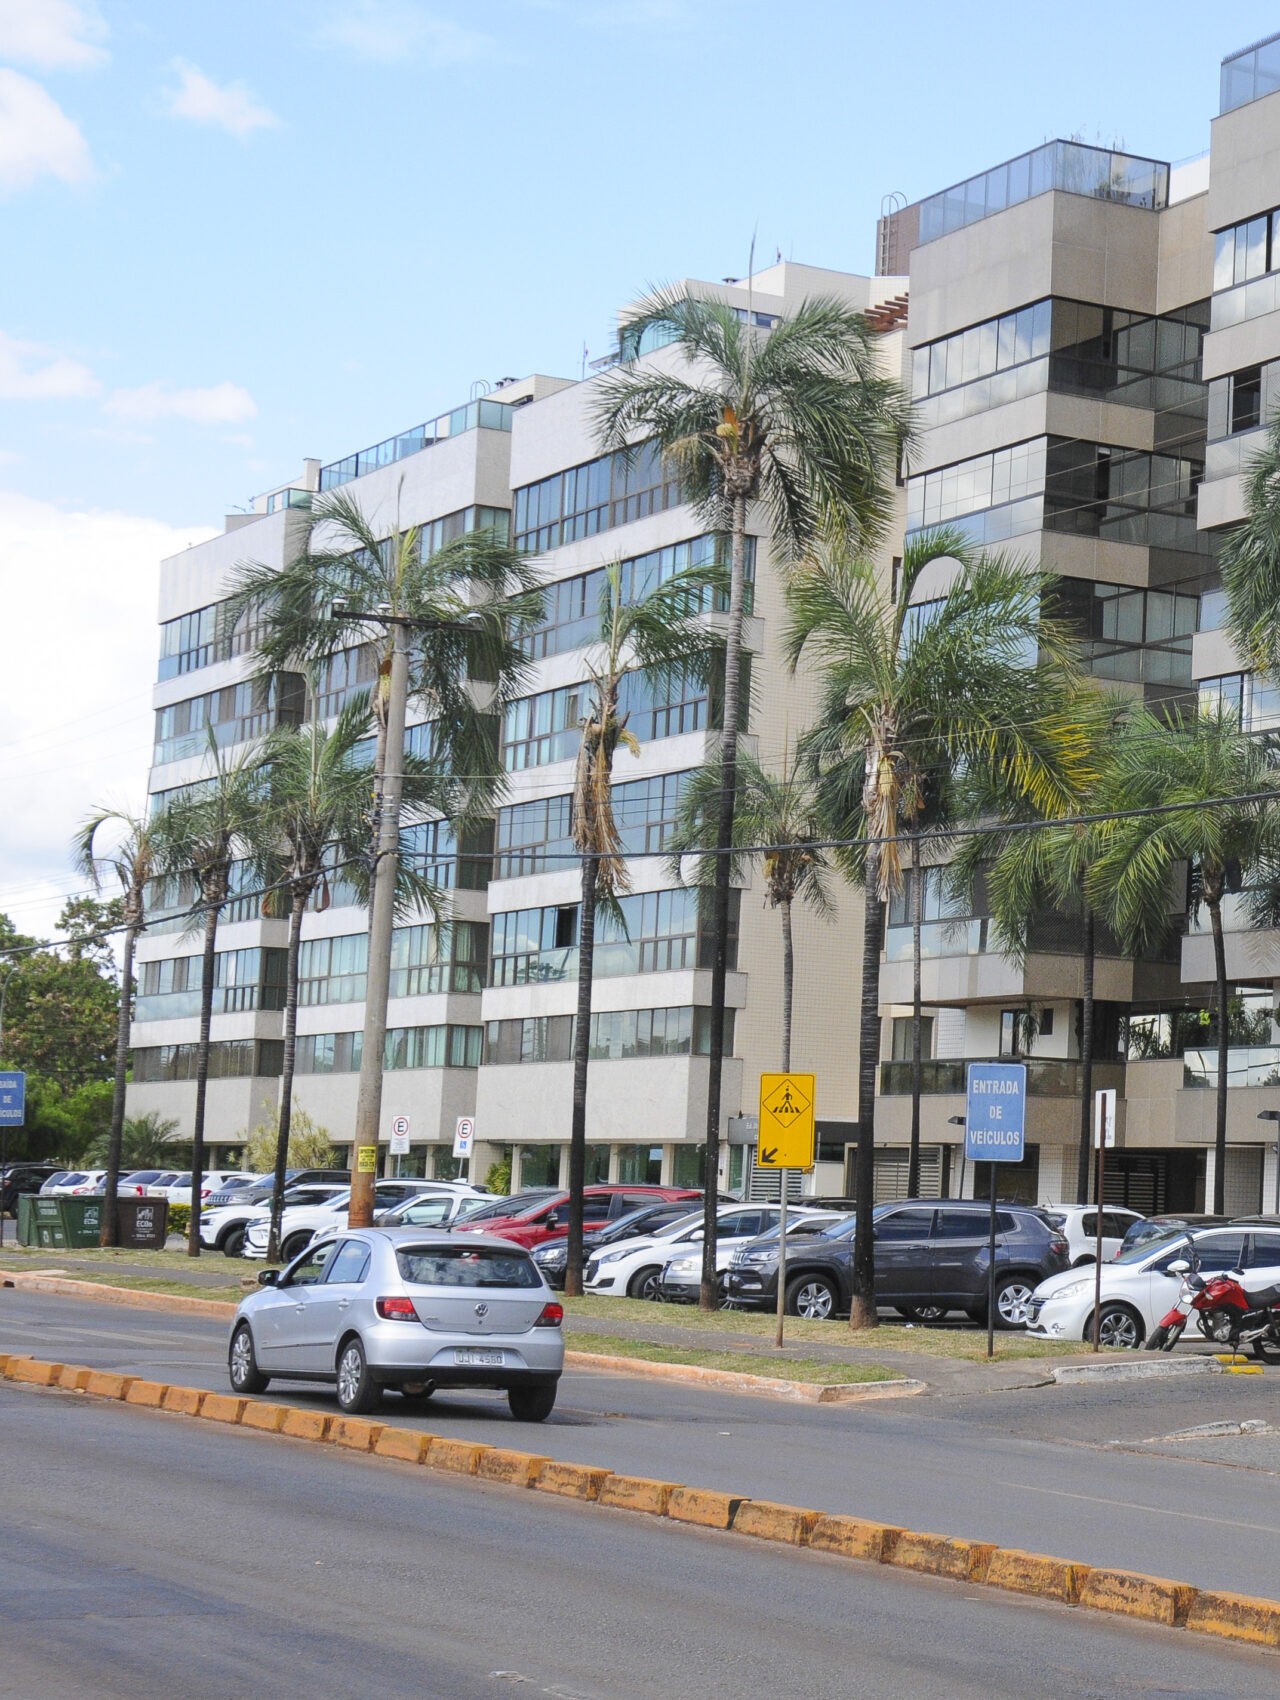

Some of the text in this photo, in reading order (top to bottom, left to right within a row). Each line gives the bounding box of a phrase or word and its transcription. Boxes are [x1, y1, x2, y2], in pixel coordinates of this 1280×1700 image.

[972, 1079, 1019, 1095] ENTRADA
[989, 1105, 1003, 1119] DE
[397, 1121, 405, 1132] E
[461, 1123, 469, 1135] E
[970, 1127, 1020, 1145] VEÍCULOS
